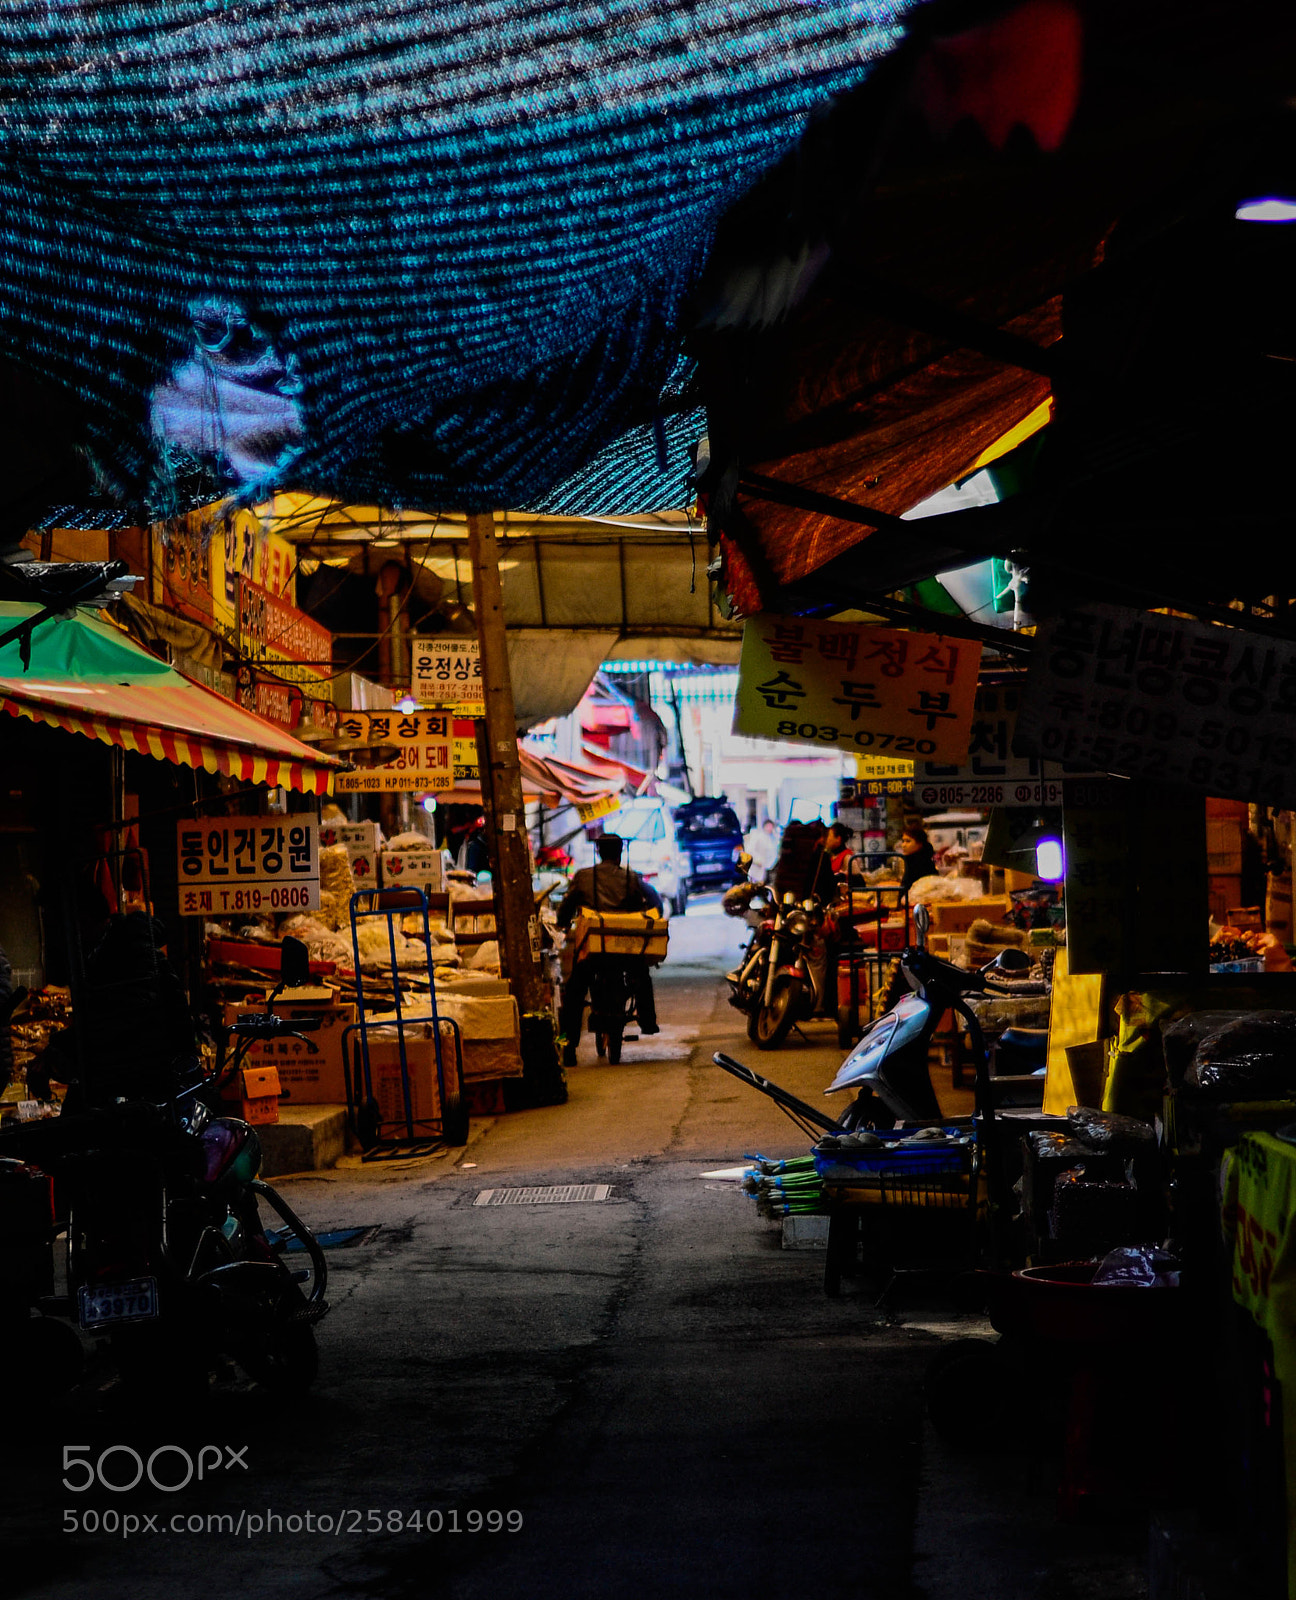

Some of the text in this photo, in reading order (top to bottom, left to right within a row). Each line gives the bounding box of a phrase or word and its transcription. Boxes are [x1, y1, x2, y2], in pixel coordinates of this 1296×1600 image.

[776, 720, 937, 755] 803-0720
[425, 745, 448, 769] 도매
[181, 826, 311, 876] 동인건강원
[220, 887, 310, 911] T.819-0806
